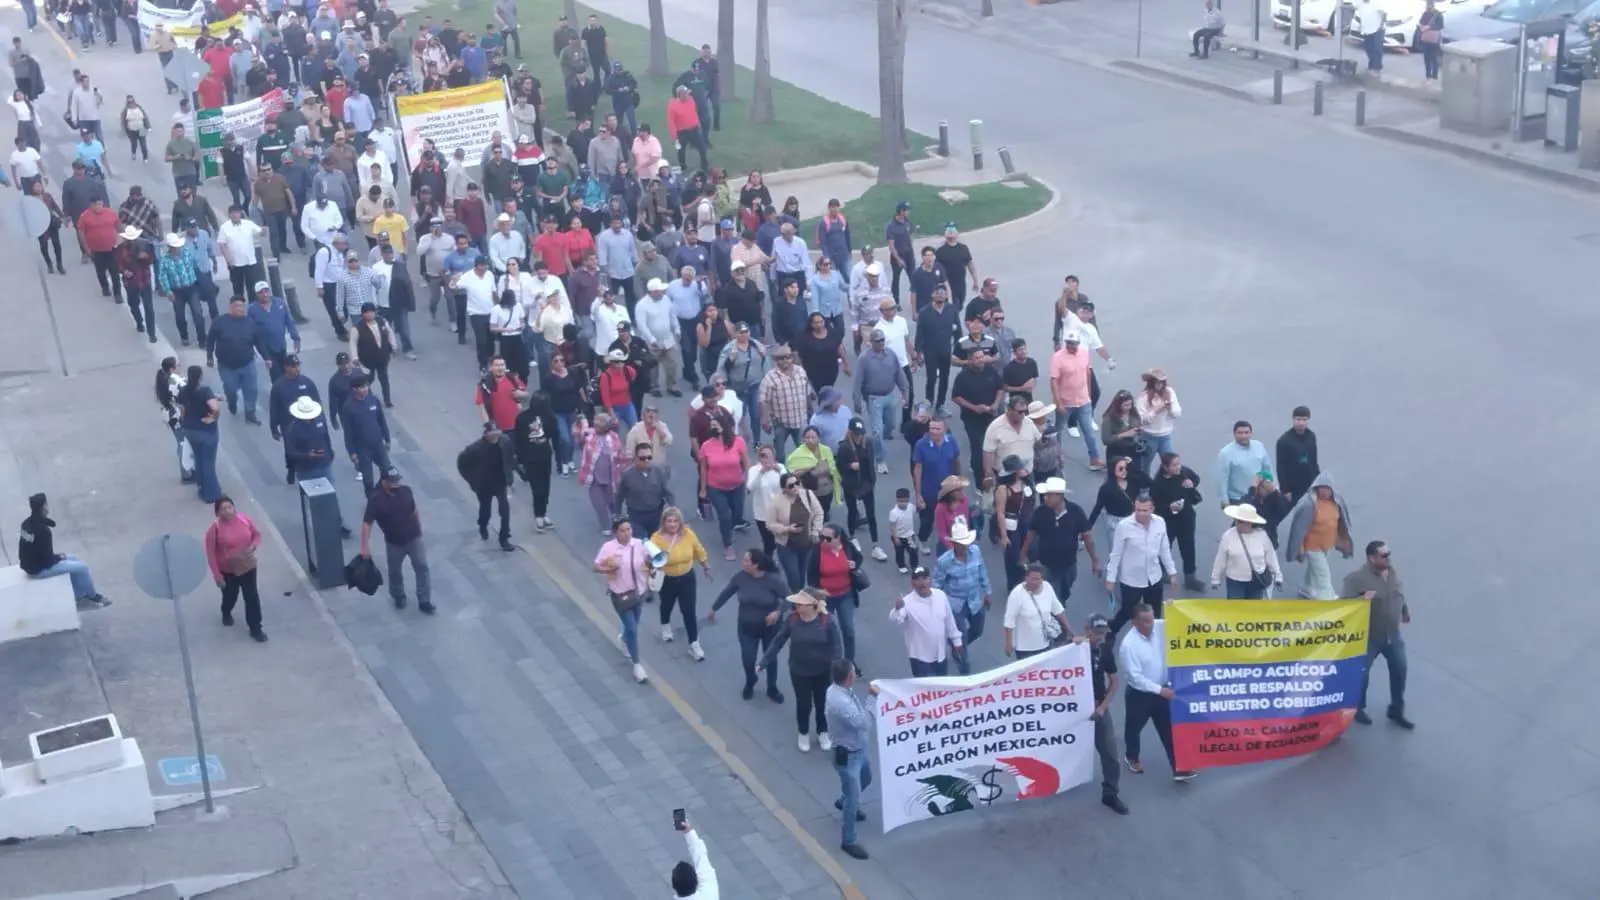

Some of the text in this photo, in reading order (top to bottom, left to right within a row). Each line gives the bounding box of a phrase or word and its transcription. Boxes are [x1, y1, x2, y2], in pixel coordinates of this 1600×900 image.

[1187, 623, 1211, 635] ¡NO
[1216, 622, 1232, 633] AL
[1184, 638, 1200, 649] AL
[1205, 637, 1290, 649] PRODUCTOR
[1295, 631, 1364, 646] NACIONAL!
[1192, 662, 1337, 683] ¡EL CAMPO ACUÍCOLA
[880, 700, 906, 717] ¡LA
[1017, 666, 1085, 682] SECTOR
[1209, 681, 1324, 696] EXIGE RESPALDO
[896, 685, 1076, 727] ES NUESTRA FUERZA!
[1189, 692, 1345, 714] DE NUESTRO GOBIERNO!
[886, 702, 1079, 747] HOY MARCHAMOS POR
[1204, 727, 1240, 740] ¡ALTO
[1243, 727, 1256, 736] AL
[917, 720, 1046, 755] EL FUTURO DEL
[1199, 740, 1242, 753] ILEGAL
[1245, 740, 1261, 750] DE
[894, 733, 1076, 777] CAMARÓN MEXICANO
